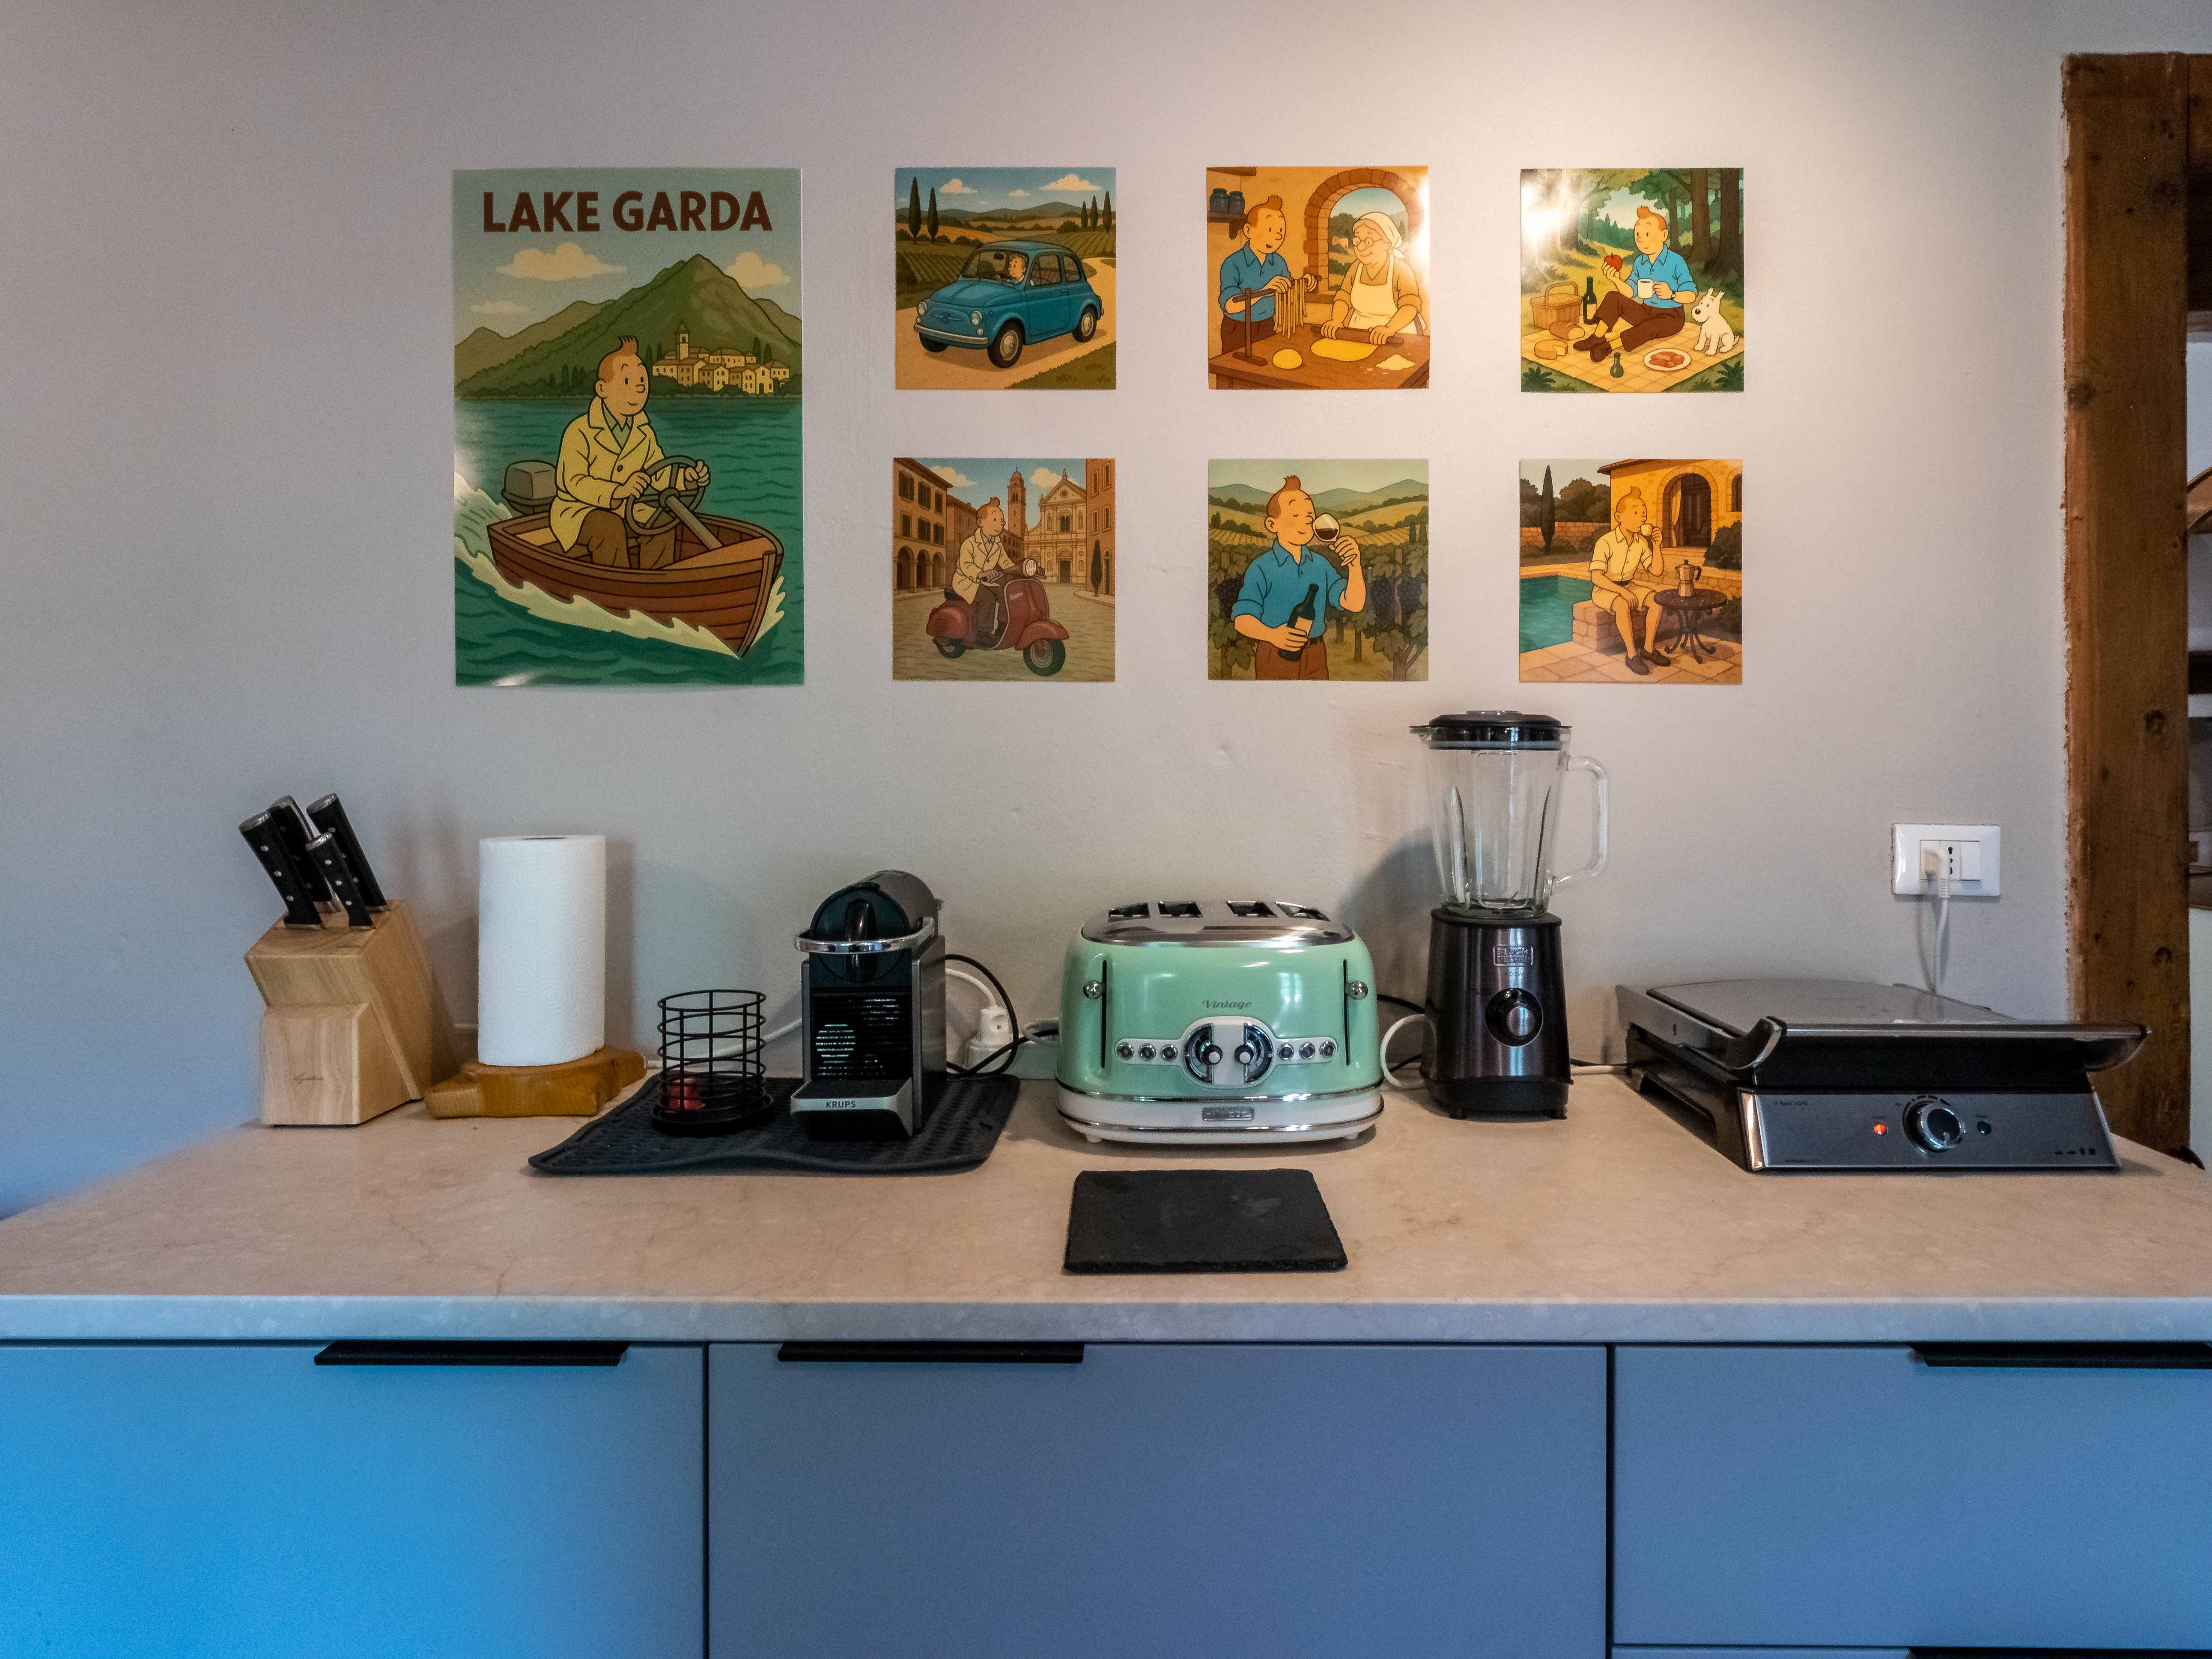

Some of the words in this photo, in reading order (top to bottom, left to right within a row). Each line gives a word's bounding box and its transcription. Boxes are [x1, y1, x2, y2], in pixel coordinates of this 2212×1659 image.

[483, 191, 600, 232] LAKE
[612, 190, 773, 232] GARDA
[1202, 1000, 1252, 1010] Vintage
[826, 1100, 856, 1108] KRUPS
